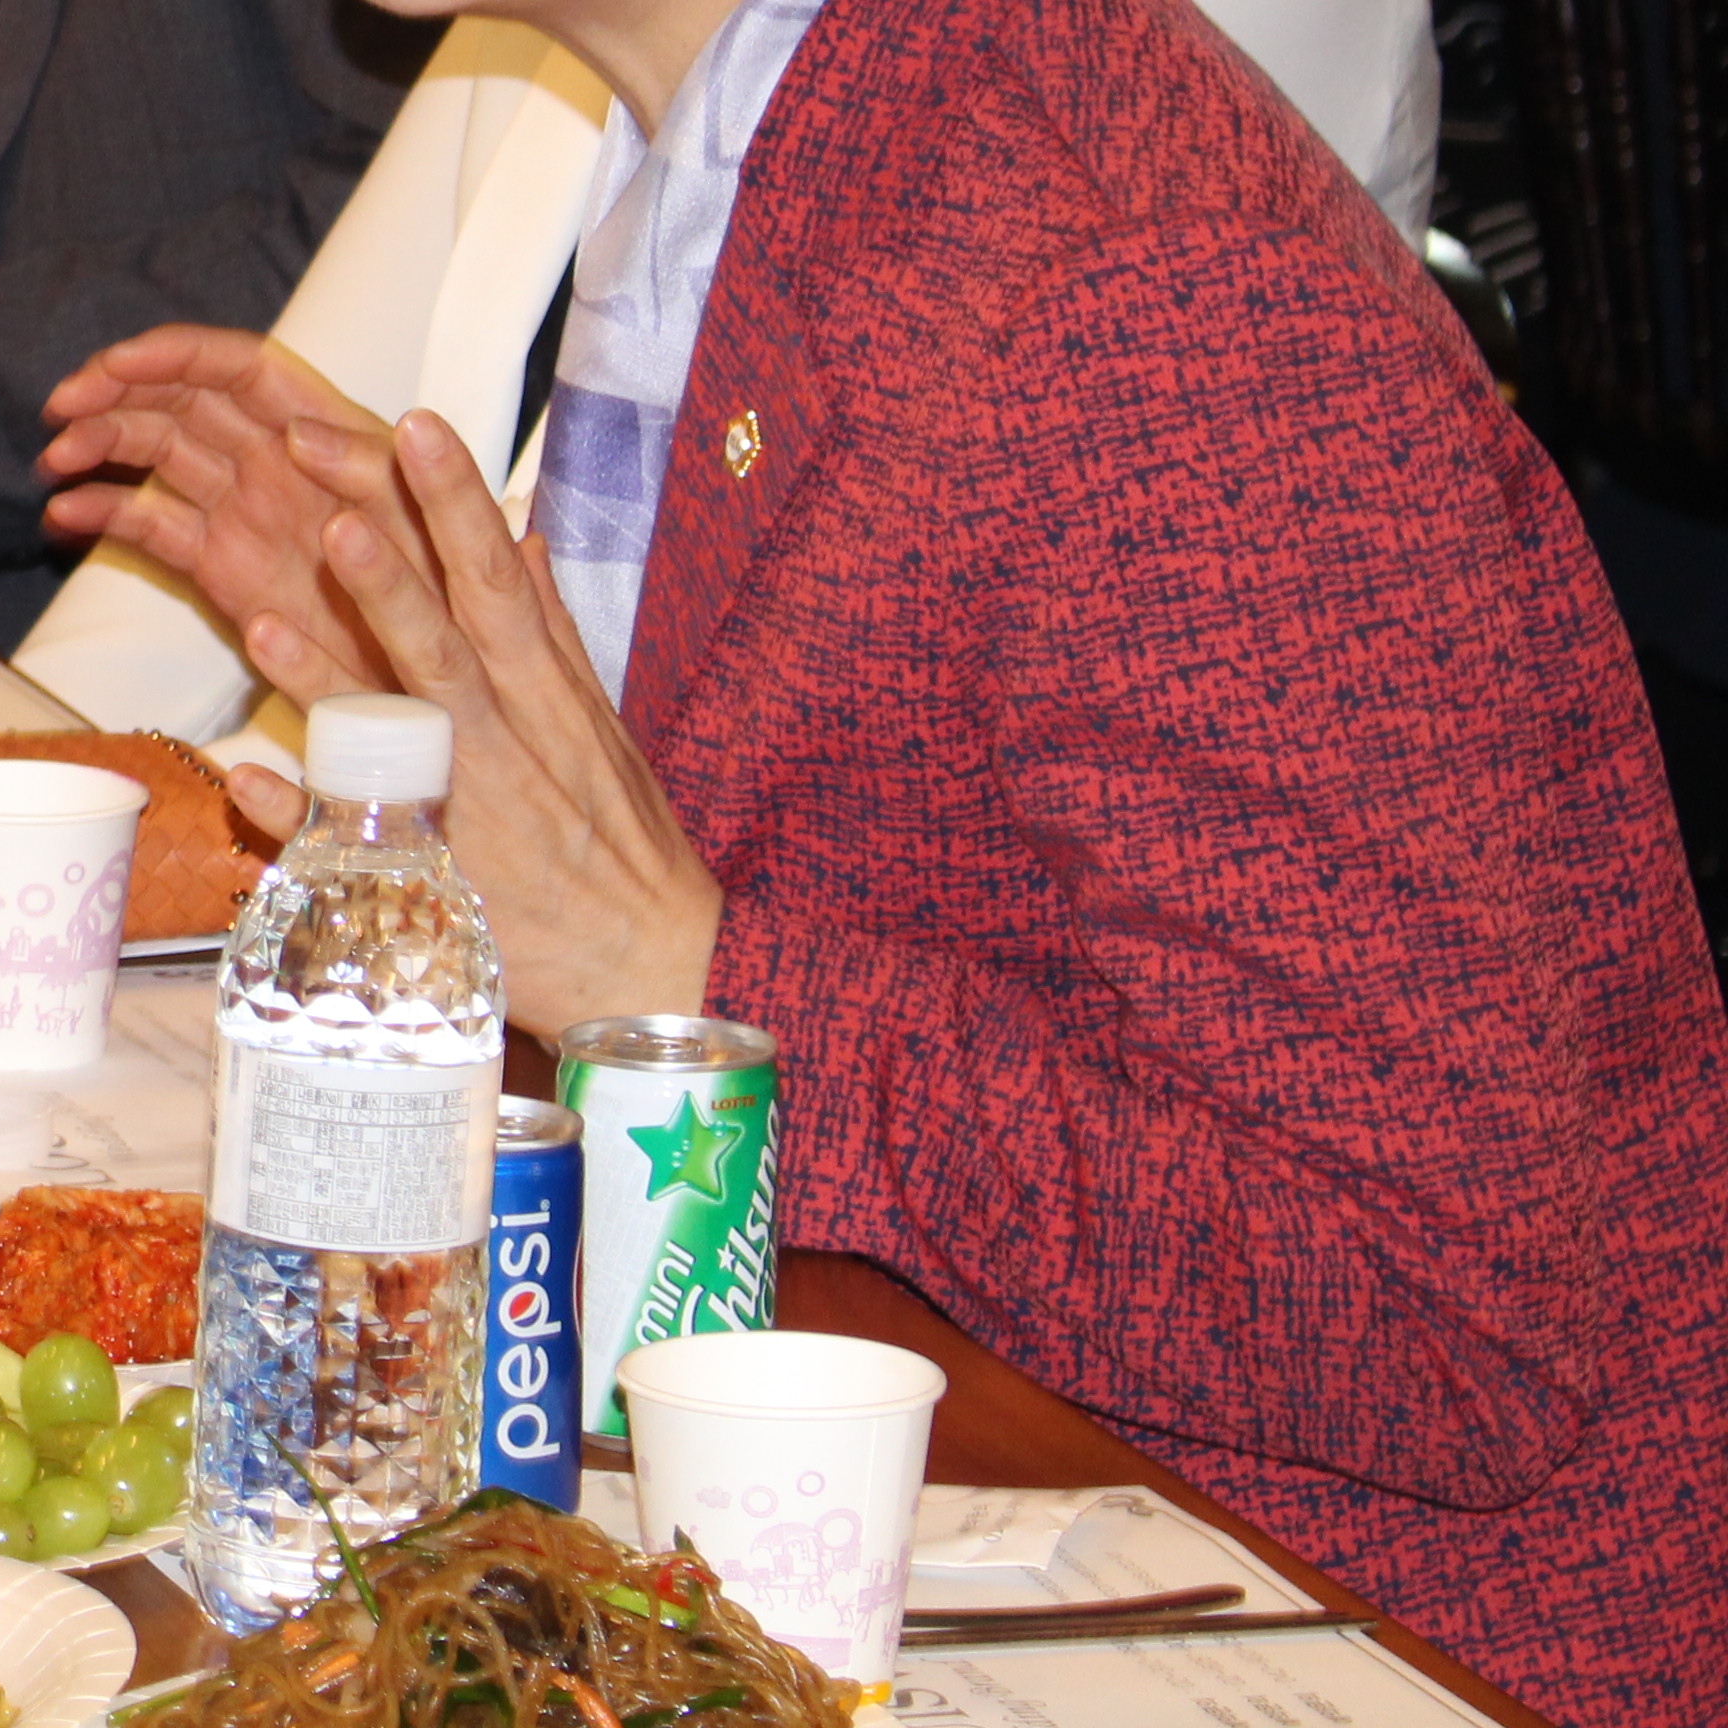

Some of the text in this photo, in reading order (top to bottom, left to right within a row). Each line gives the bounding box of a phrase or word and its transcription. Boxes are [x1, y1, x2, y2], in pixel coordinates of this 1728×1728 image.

[710, 1095, 756, 1110] LOTTE
[489, 1210, 561, 1461] pepsi
[635, 1241, 695, 1345] mini
